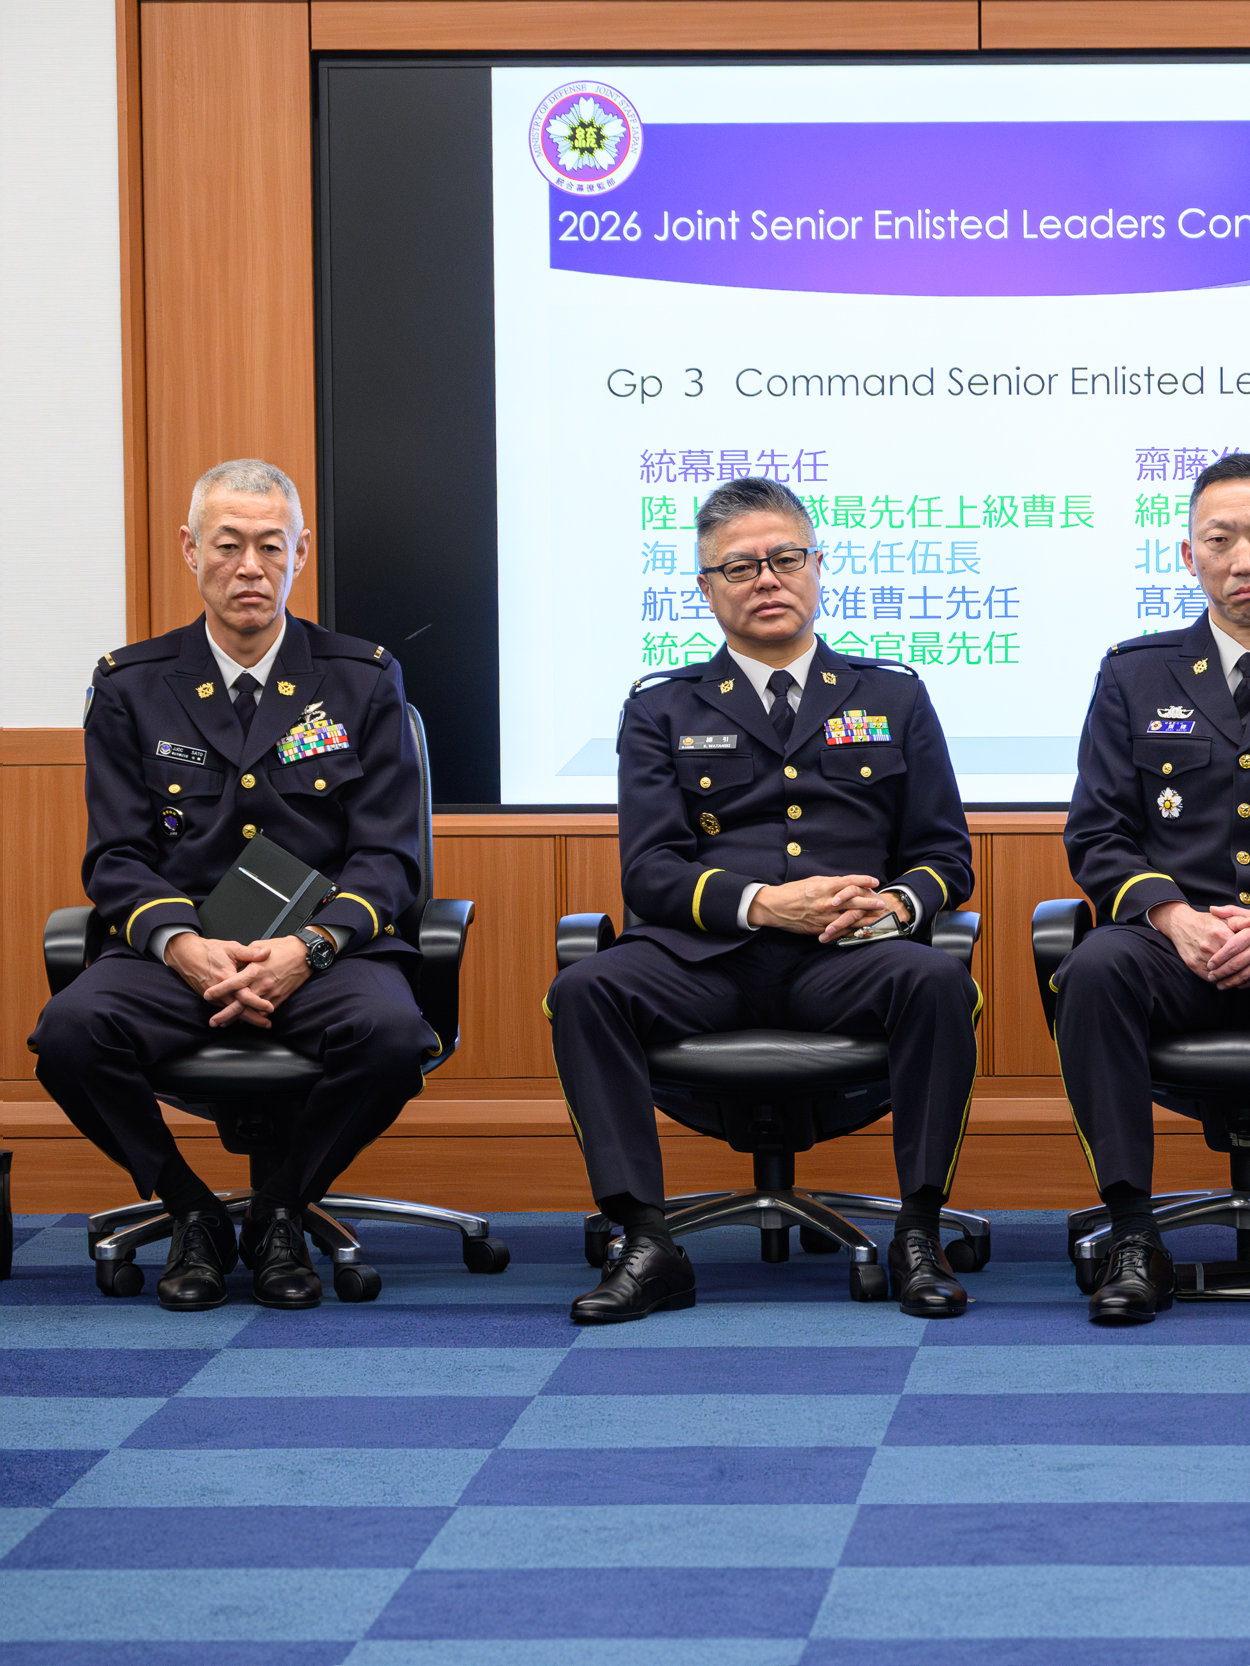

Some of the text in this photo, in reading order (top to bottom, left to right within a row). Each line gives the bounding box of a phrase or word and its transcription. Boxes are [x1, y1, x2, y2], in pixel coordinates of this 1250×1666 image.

[532, 83, 641, 158] MINISTRY OF DEFENSE JOINT STAFF JAPAN
[558, 210, 642, 242] 2026
[653, 209, 740, 242] Joint
[750, 208, 863, 241] Senior
[874, 208, 1008, 240] Enlisted
[1022, 208, 1166, 240] Leaders
[607, 368, 663, 404] Gp
[684, 367, 704, 398] 3
[735, 367, 934, 397] Command
[947, 365, 1059, 397] Senior
[1071, 365, 1204, 396] Enlisted
[640, 449, 829, 483] 統幕最先任
[641, 494, 1095, 530] 陸上隊最先任上級曹長
[641, 631, 1021, 666] 統合令官最先任
